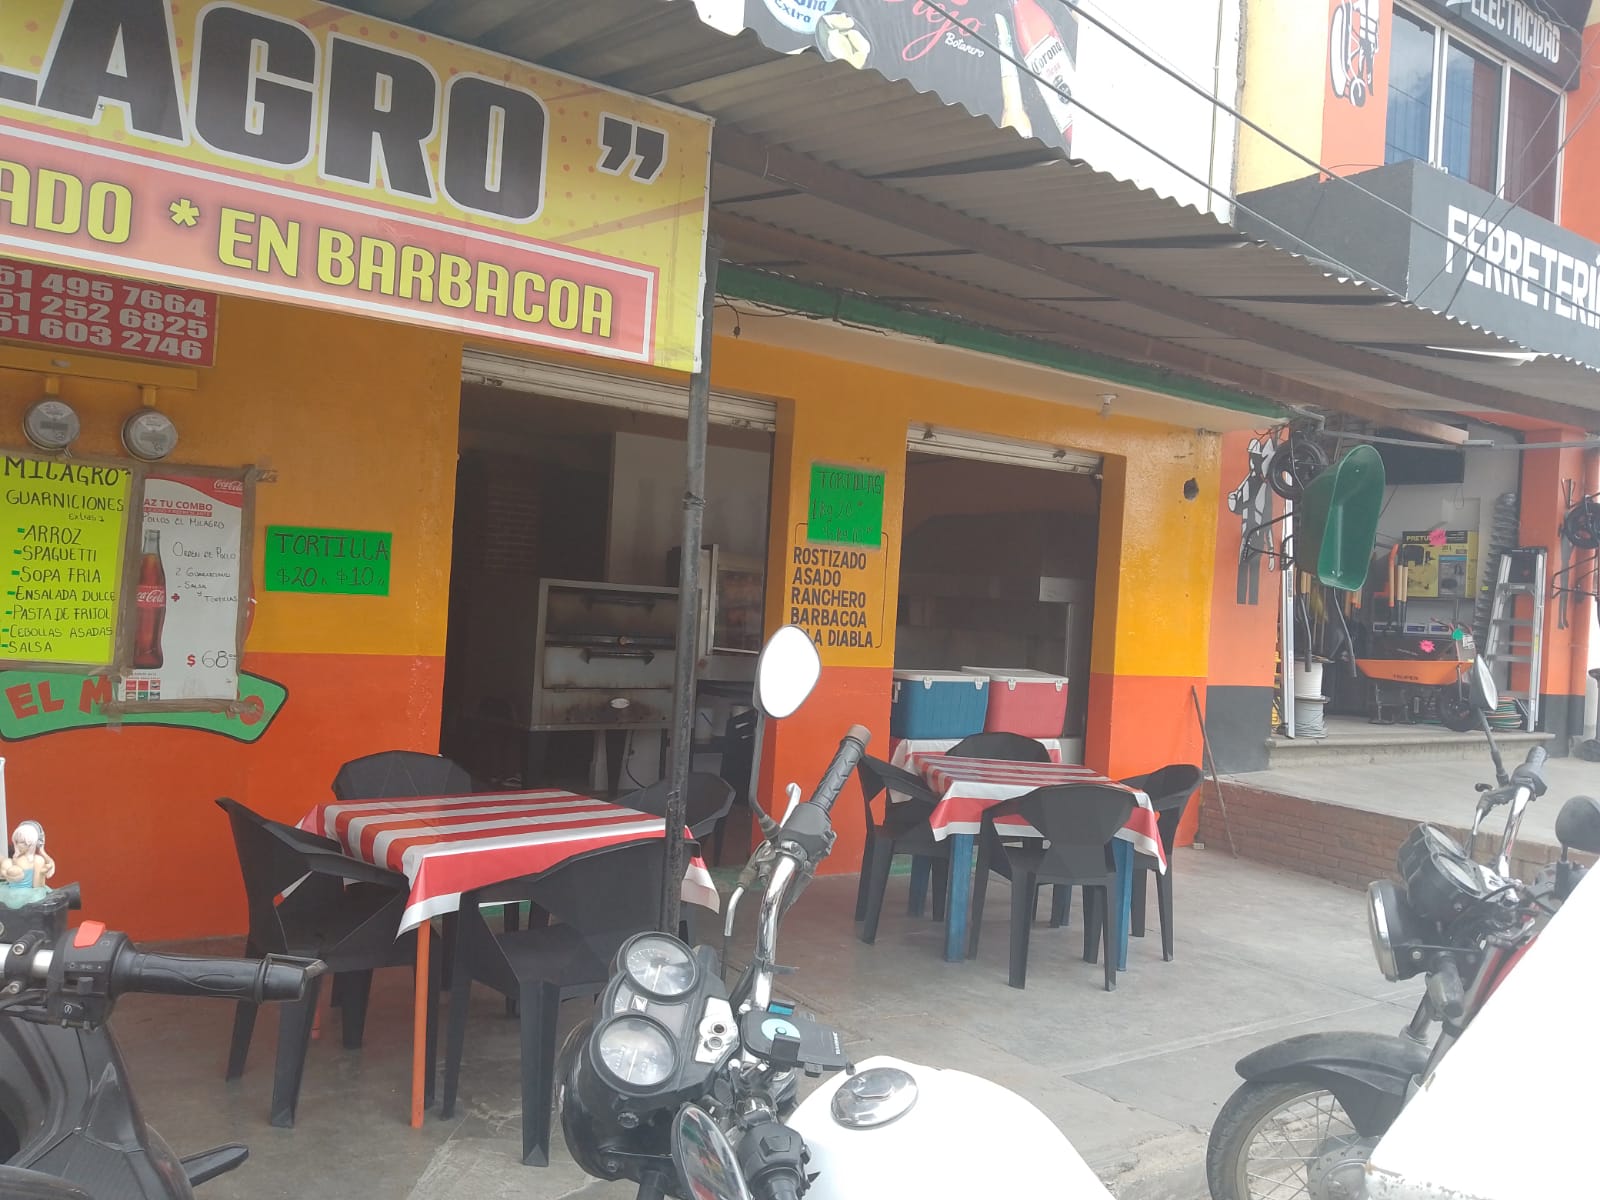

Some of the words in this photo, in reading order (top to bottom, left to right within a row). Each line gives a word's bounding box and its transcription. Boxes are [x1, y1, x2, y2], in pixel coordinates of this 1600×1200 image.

[945, 32, 985, 58] Botanero
[1031, 41, 1063, 75] Corona
[218, 207, 301, 278] EN
[317, 226, 613, 338] BARBACOA
[1445, 204, 1600, 329] FERRETERÍ
[42, 273, 113, 302] 495
[123, 285, 206, 318] 7664
[41, 295, 110, 323] 252
[119, 308, 208, 339] 6825
[40, 318, 112, 346] 603
[121, 331, 202, 360] 2746
[6, 489, 124, 512] GUARNICIONES
[160, 500, 173, 509] TU
[176, 501, 213, 511] COMBO
[23, 525, 82, 545] ARROZ
[1406, 535, 1433, 543] PRETU
[22, 545, 97, 562] SPAGUETTI
[274, 533, 389, 560] TORTILLA
[793, 546, 867, 570] ROSTIZADO
[20, 566, 60, 583] SOPA
[68, 567, 100, 583] FRIA
[792, 566, 841, 587] ASADO
[16, 586, 77, 601] ENSALADA
[82, 591, 115, 602] DULCE
[791, 587, 866, 608] RANCHERO
[13, 604, 51, 620] PASTA
[55, 608, 69, 621] DE
[74, 607, 111, 621] FRIJOL
[790, 607, 868, 628] BARBACOA
[9, 625, 63, 639] CEBOLLAS
[70, 626, 113, 639] ASADAS
[807, 629, 823, 646] A
[828, 630, 873, 648] DIABLA
[7, 640, 53, 653] SALSA
[5, 680, 64, 720] EL
